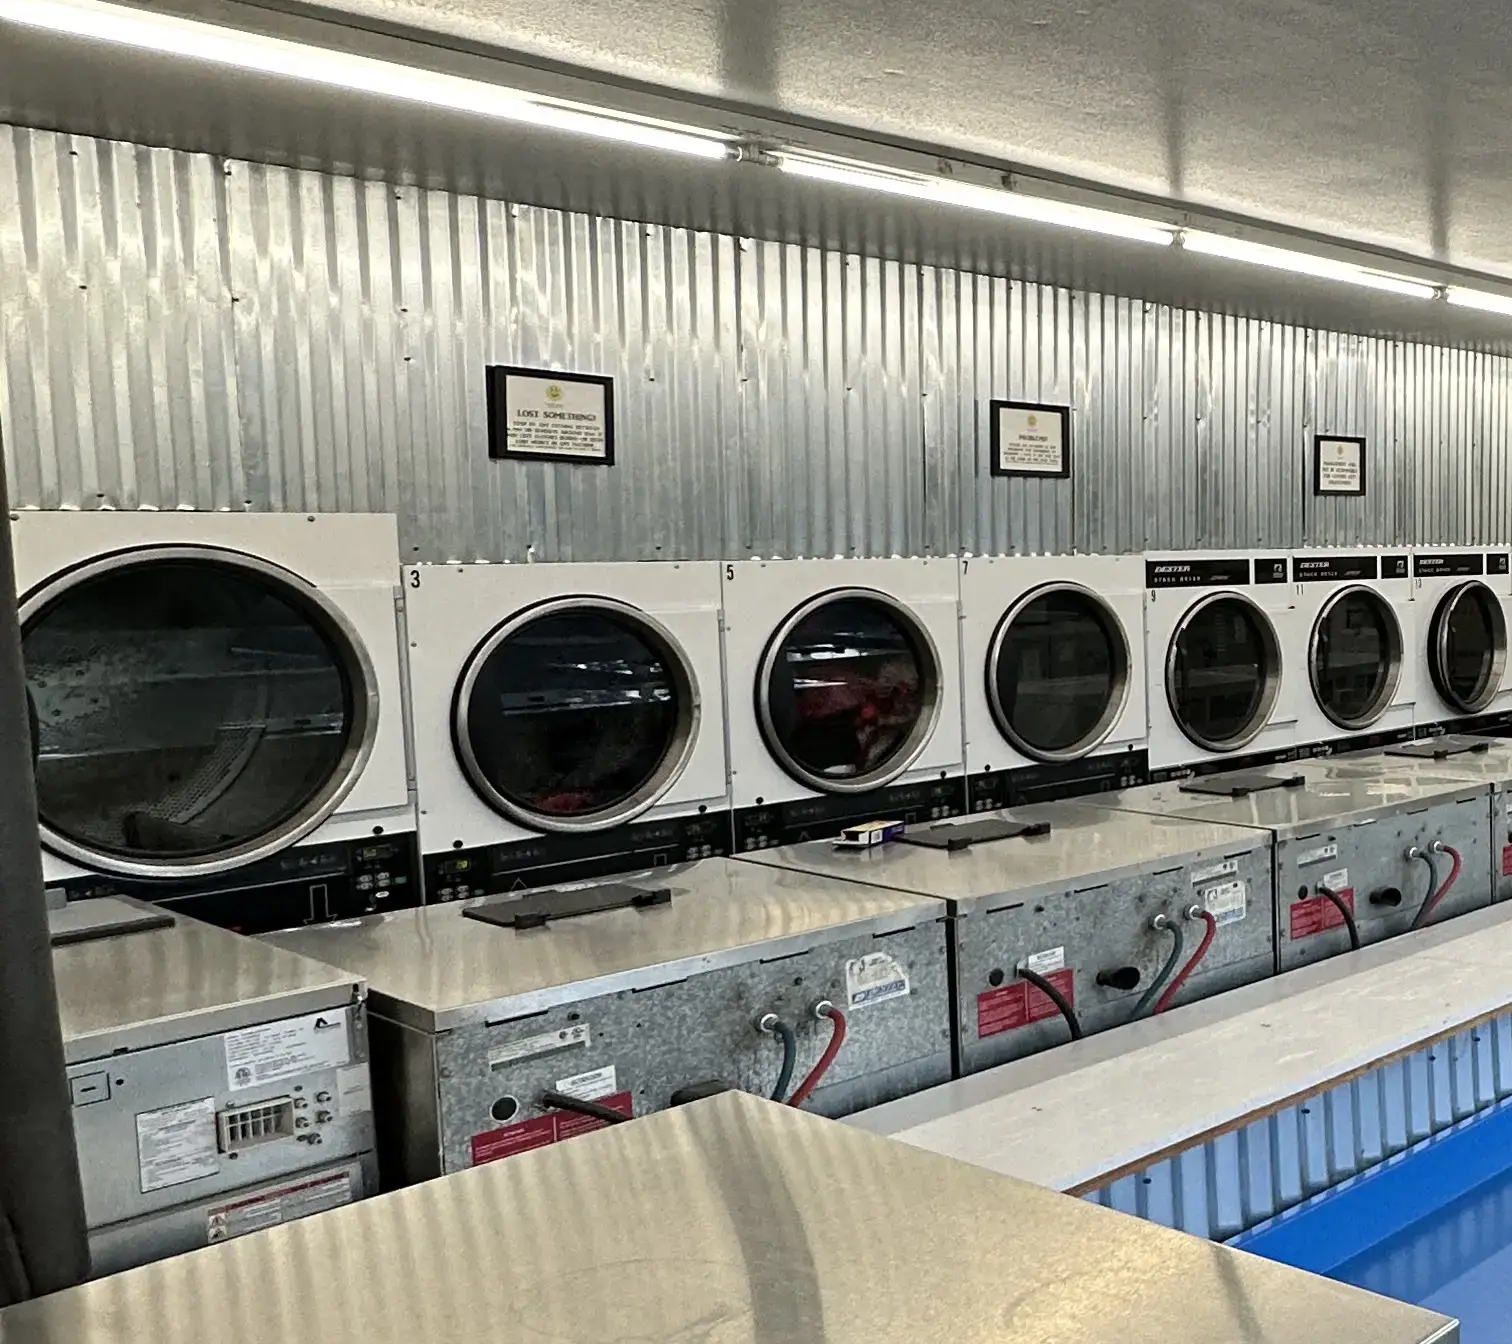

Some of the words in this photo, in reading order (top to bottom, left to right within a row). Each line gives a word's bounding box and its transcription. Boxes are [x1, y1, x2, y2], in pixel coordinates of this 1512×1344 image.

[517, 409, 538, 418] LOST
[726, 563, 734, 581] 5
[962, 560, 969, 575] 7
[1154, 565, 1191, 573] DEXTER
[410, 569, 421, 588] 3
[1151, 589, 1156, 602] 9
[1296, 584, 1304, 596] 11
